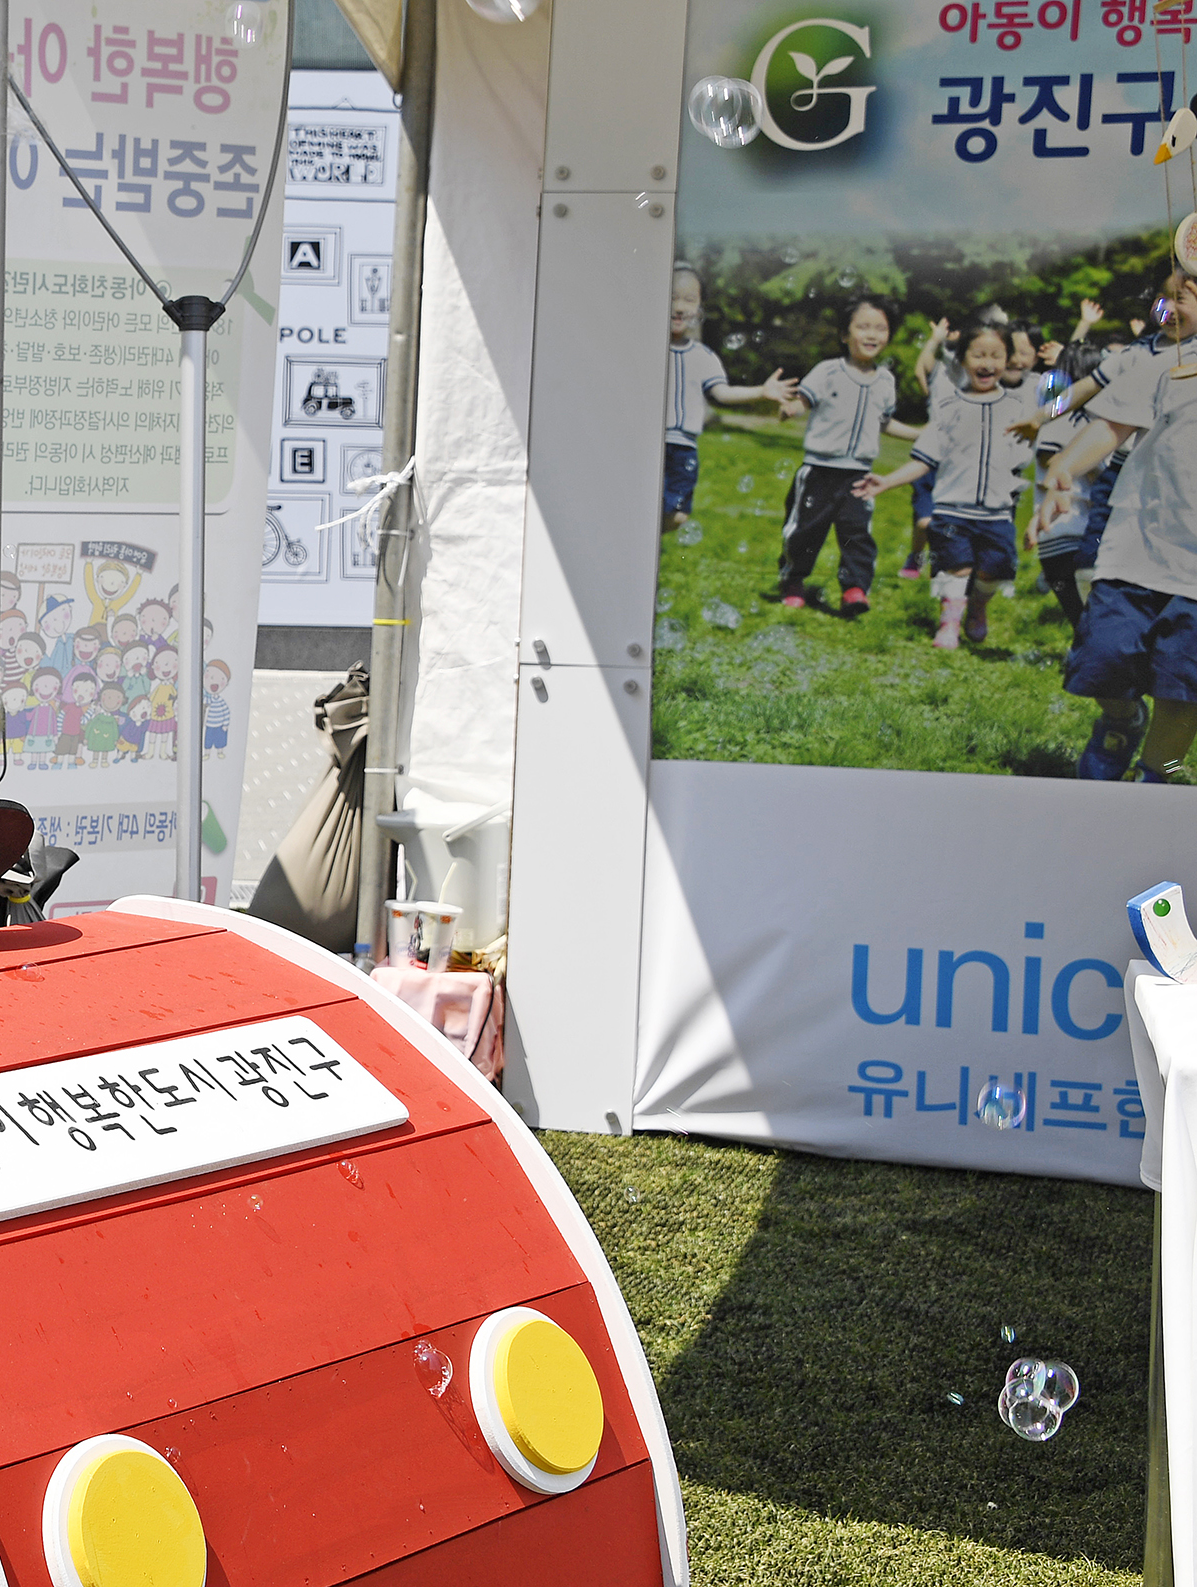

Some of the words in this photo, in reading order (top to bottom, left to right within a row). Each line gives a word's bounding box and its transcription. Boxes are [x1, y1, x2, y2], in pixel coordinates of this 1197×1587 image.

[938, 0, 1081, 51] 아동이
[931, 71, 1177, 164] 광진구
[290, 242, 321, 270] A
[280, 327, 347, 344] POLE
[851, 921, 1124, 1041] unic
